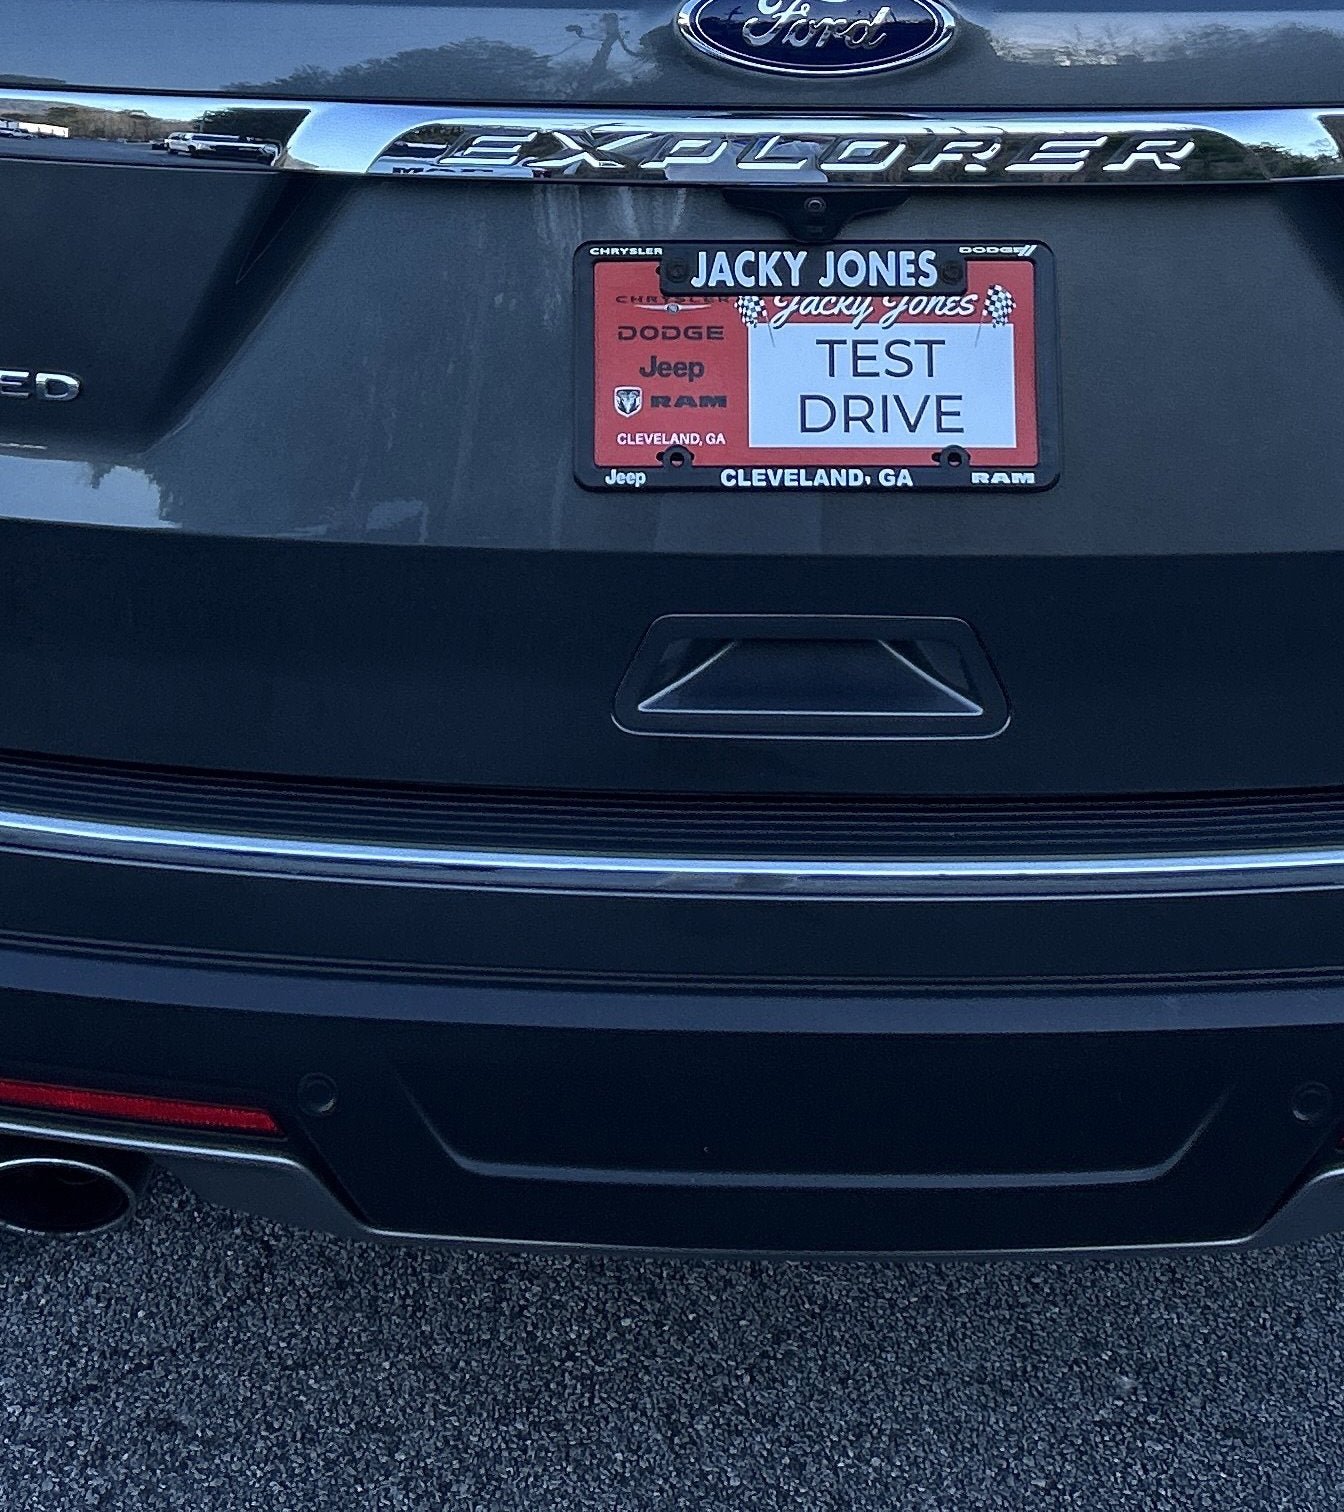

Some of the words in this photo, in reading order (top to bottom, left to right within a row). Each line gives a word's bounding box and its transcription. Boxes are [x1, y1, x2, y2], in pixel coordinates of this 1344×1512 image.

[436, 128, 1198, 174] EXPLORER
[589, 247, 663, 256] CHRYSLER
[959, 246, 1024, 254] DODGE
[690, 250, 807, 288] JACKY
[818, 250, 938, 288] JONES
[770, 294, 874, 329] Jacky
[878, 294, 978, 329] Jones
[617, 325, 724, 341] DODGE
[816, 338, 946, 378] TEST
[639, 355, 705, 382] Jeep
[650, 395, 727, 408] RAM
[800, 394, 964, 434] DRIVE
[616, 432, 703, 446] CLEVELAND,
[705, 432, 726, 445] GA
[605, 469, 647, 487] Jeep
[720, 468, 872, 487] CLEVELAND,
[878, 468, 914, 487] GA
[971, 472, 1035, 484] RAM
